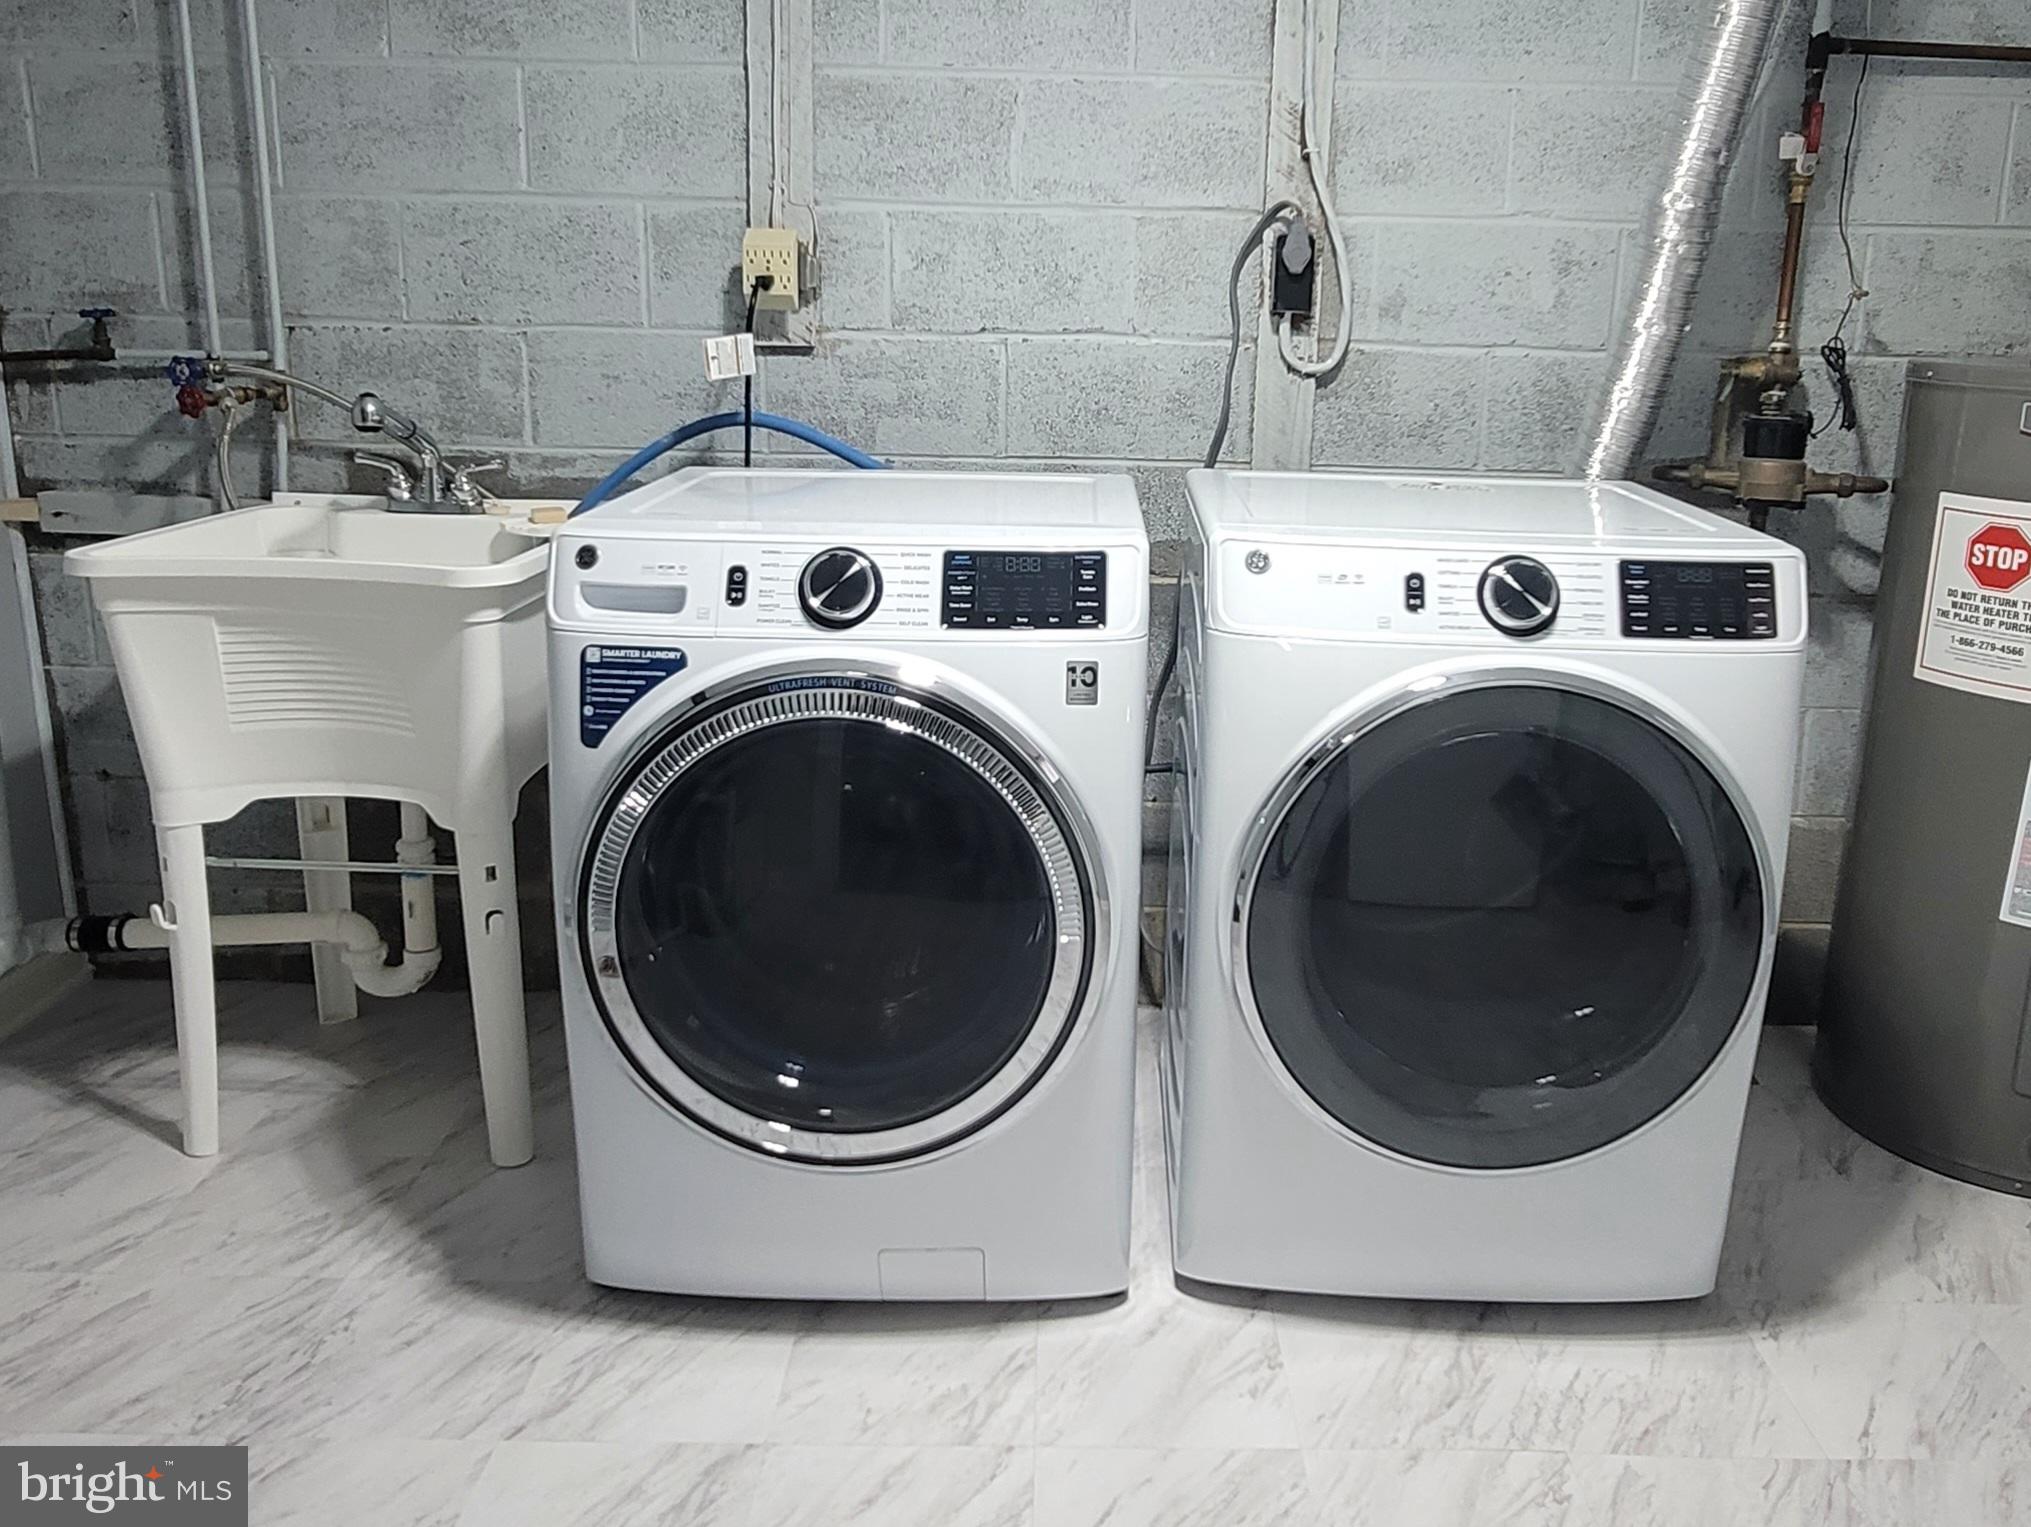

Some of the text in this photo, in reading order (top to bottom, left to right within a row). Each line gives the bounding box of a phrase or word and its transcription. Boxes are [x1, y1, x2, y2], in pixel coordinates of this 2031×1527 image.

[1971, 542, 2029, 571] STOP
[1947, 588, 1958, 598] DO
[1960, 591, 1979, 602] NOT
[1980, 594, 2019, 609] RETURN
[1936, 607, 1951, 619] THE
[1953, 612, 1981, 625] PLACE
[1983, 617, 1997, 628] OF
[1998, 620, 2031, 634] PURCH
[1951, 600, 1980, 614] WATER
[1982, 606, 2020, 620] HEATER
[602, 649, 682, 660] SMARTER LAUNDRY
[1950, 635, 2025, 657] 1-866-279-4566
[768, 677, 897, 694] ULTRAFRESH VENT SYSTEM
